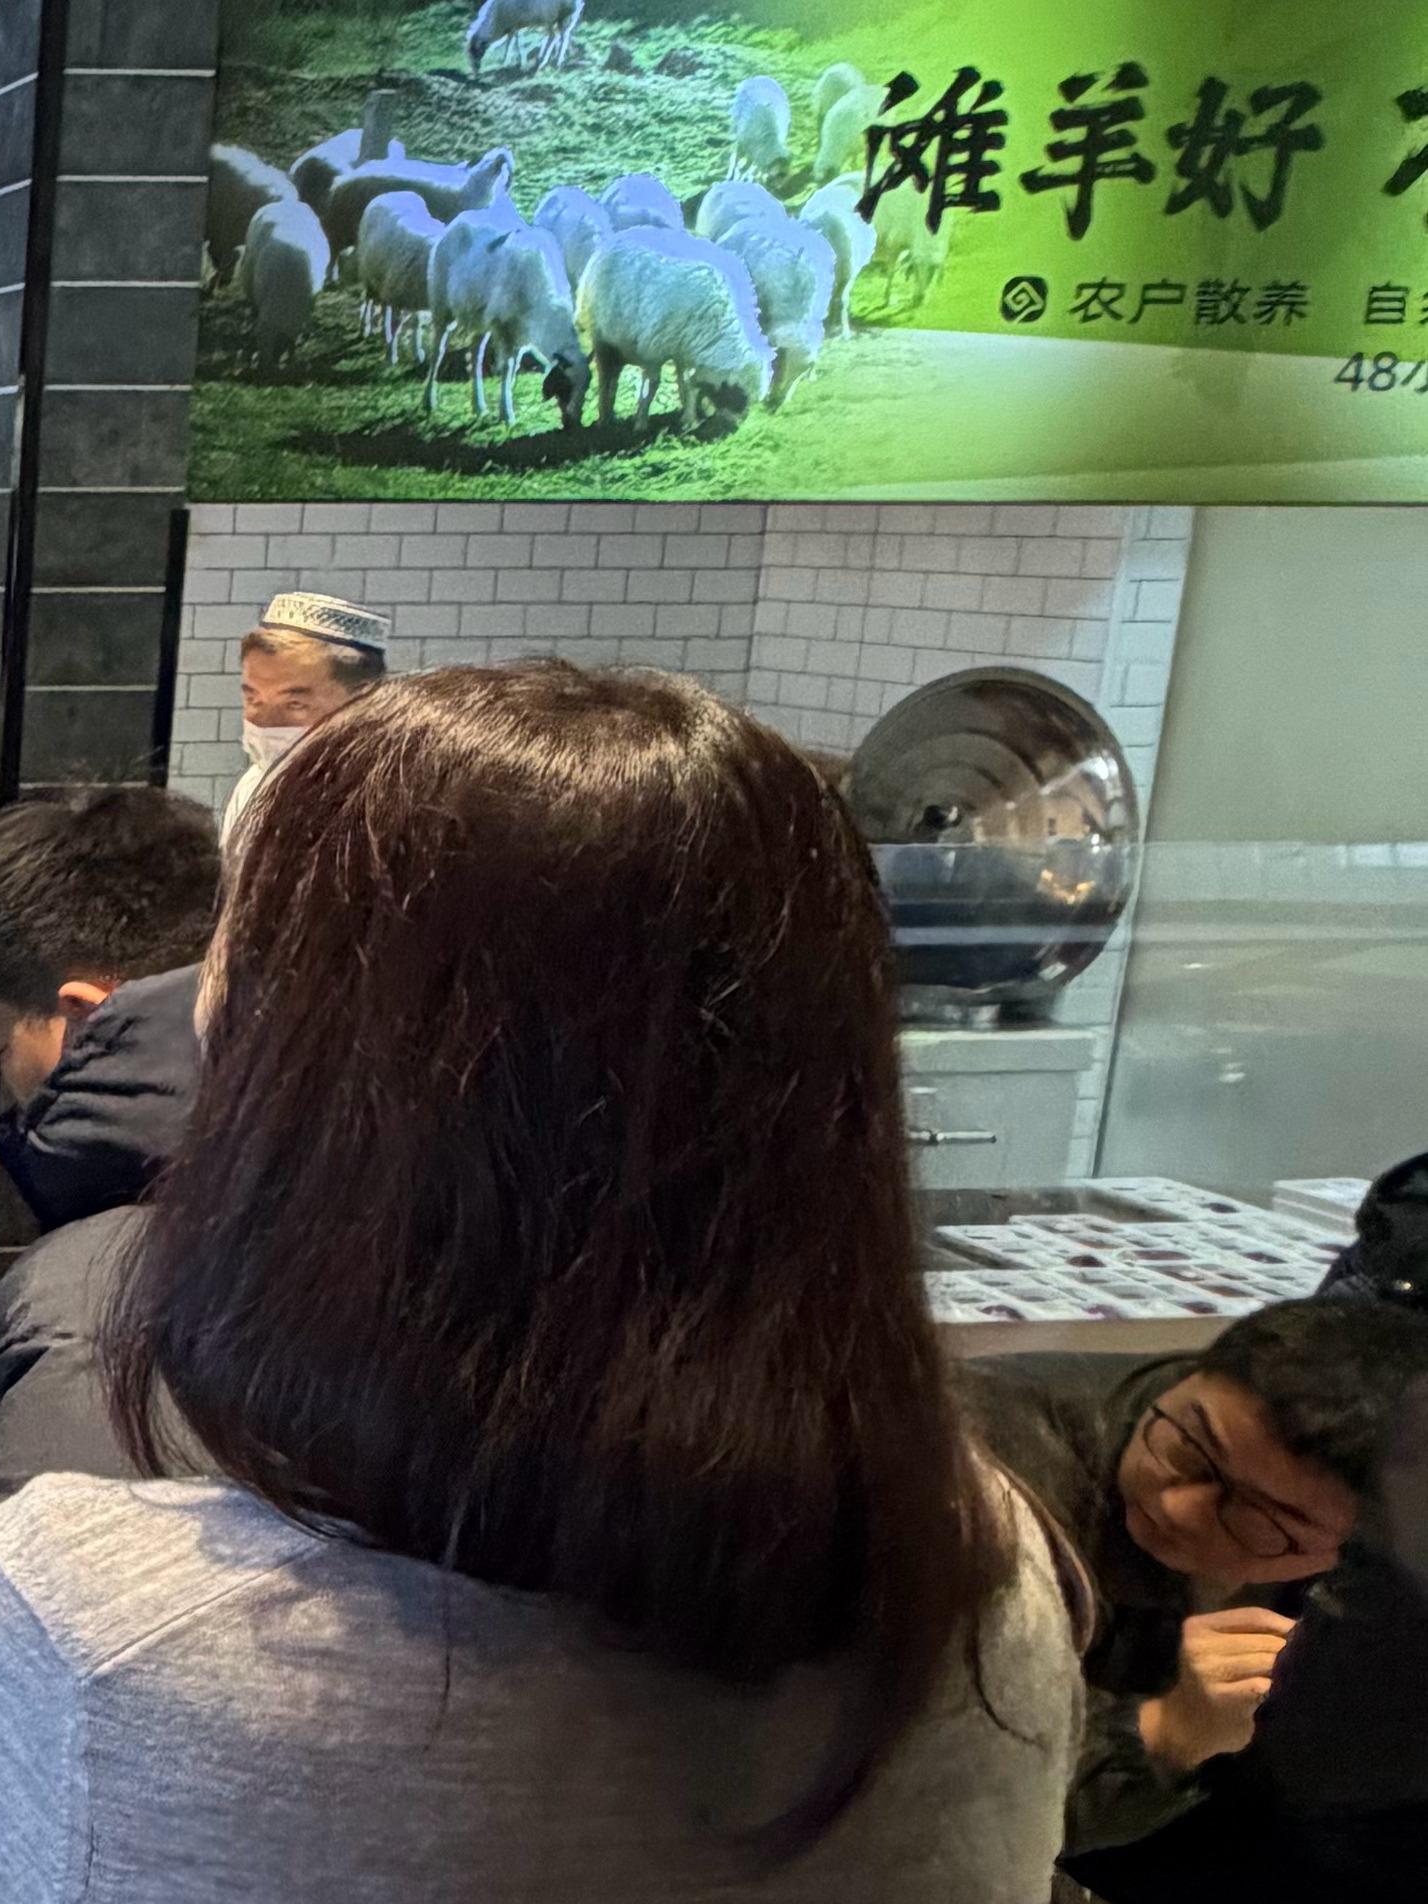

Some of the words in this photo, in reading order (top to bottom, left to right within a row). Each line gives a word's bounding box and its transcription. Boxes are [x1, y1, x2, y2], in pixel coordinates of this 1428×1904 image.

[854, 60, 1326, 242] 滩羊好
[1067, 277, 1312, 327] 农户散养
[1364, 280, 1428, 326] 自
